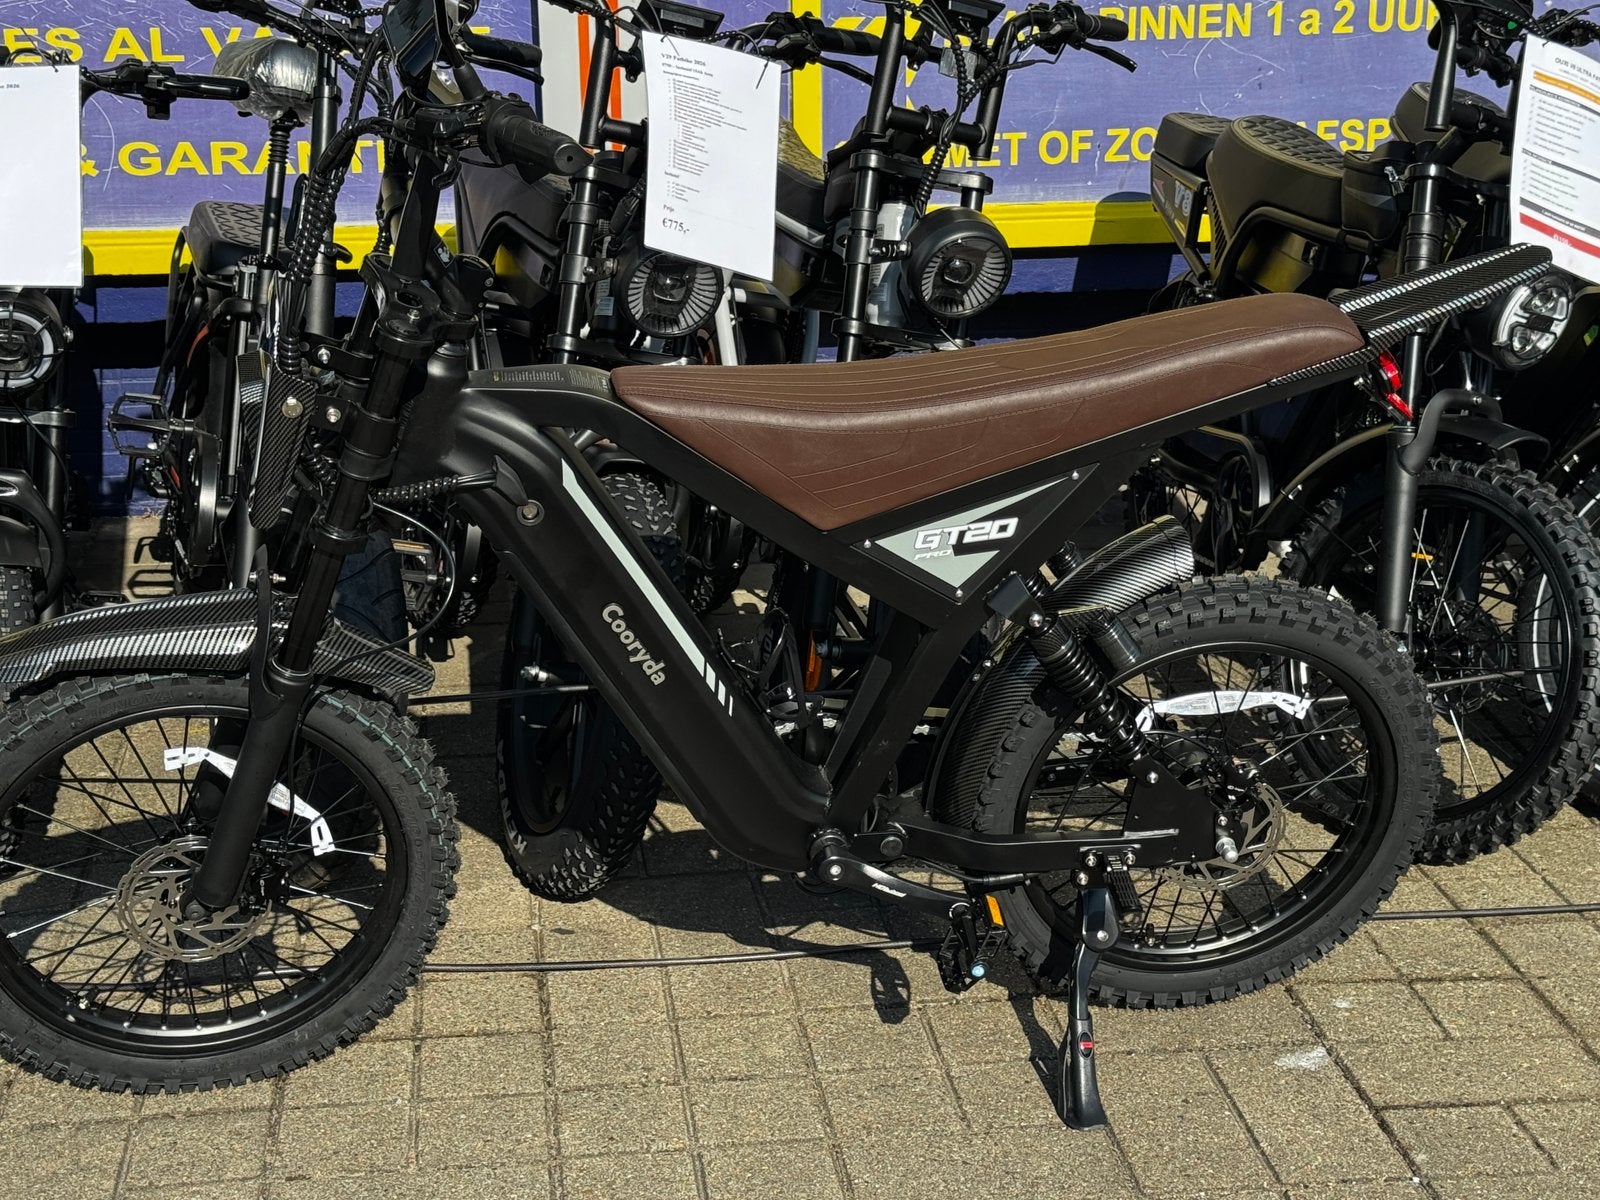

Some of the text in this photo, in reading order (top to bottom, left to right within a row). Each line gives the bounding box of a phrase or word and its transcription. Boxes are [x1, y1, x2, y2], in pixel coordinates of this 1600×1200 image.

[1267, 1, 1284, 36] 1
[1298, 8, 1321, 35] a
[1332, 0, 1356, 34] 2
[104, 27, 185, 62] AL
[1038, 129, 1094, 165] OF
[662, 217, 690, 234] €775,-
[914, 516, 1019, 550] GT20
[914, 549, 953, 560] PRO
[602, 603, 666, 686] Cooryda
[497, 738, 528, 858] KENDA
